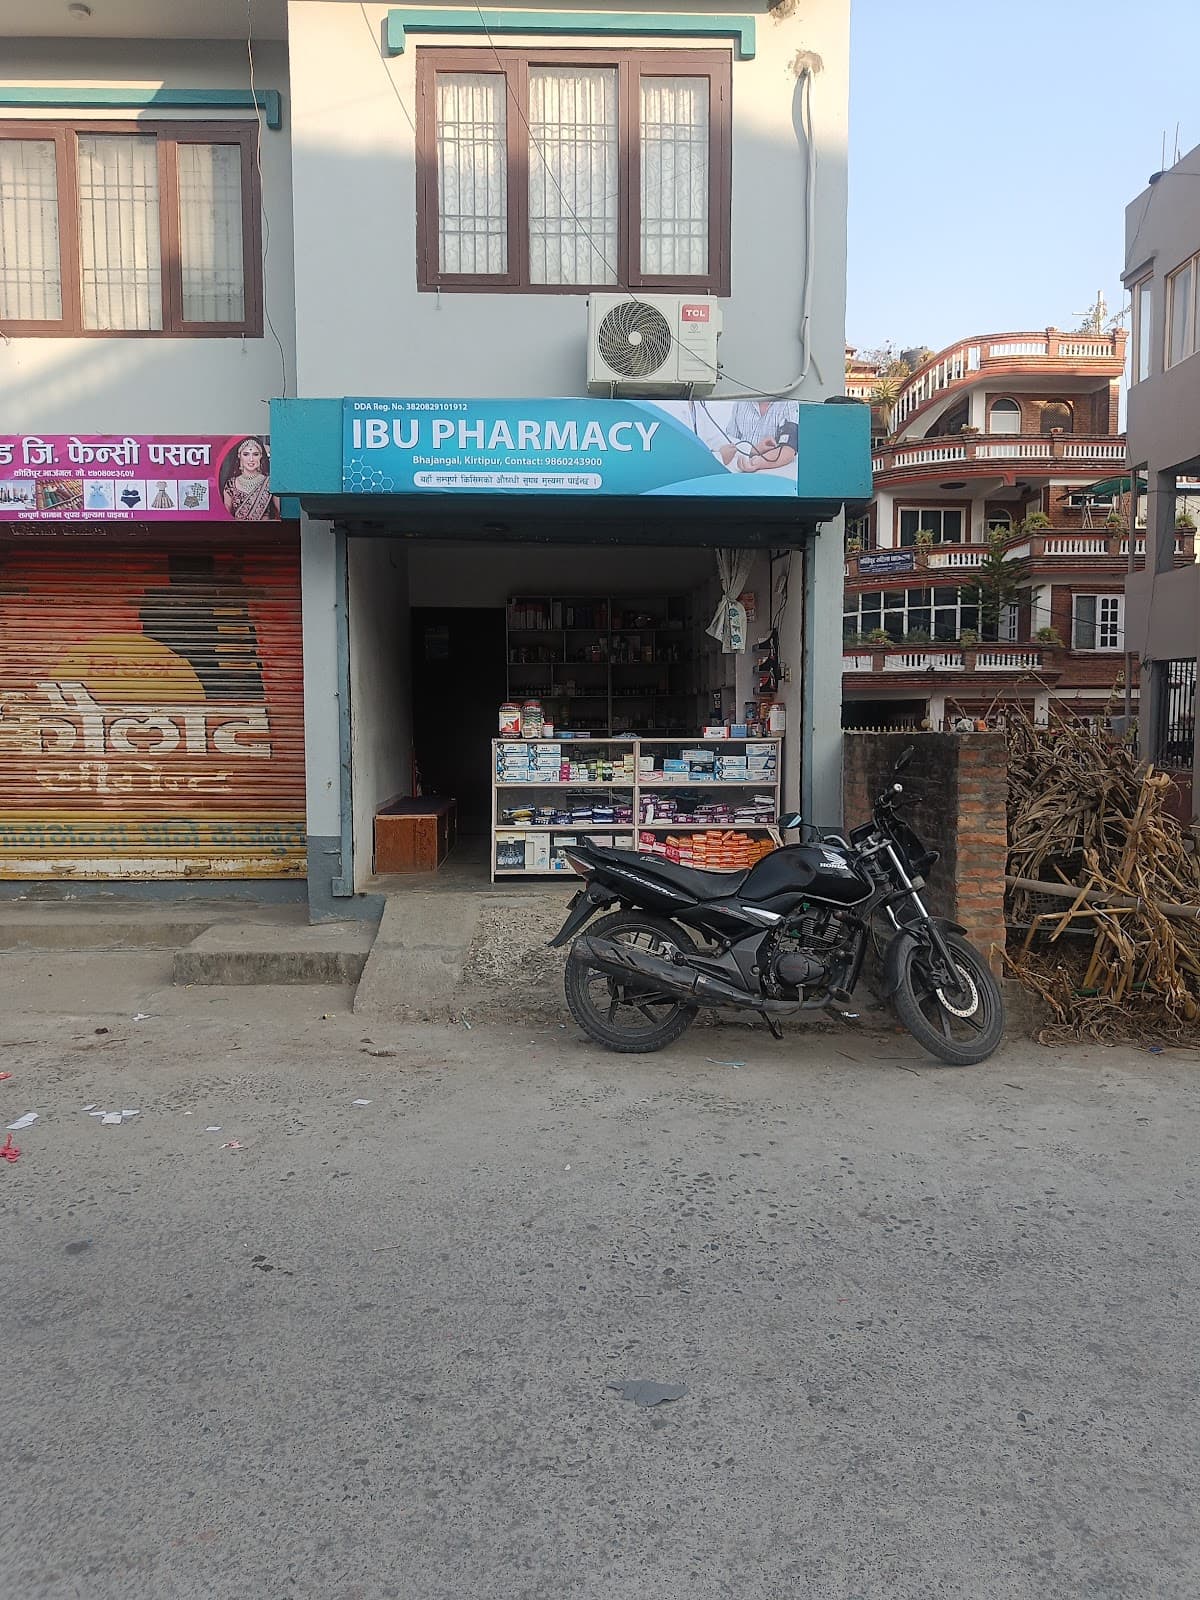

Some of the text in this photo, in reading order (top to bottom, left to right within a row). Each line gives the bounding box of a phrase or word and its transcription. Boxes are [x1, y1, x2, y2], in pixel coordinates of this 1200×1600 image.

[685, 309, 705, 317] TCL
[373, 403, 390, 411] Reg.
[352, 418, 660, 451] IBU PHARMACY
[67, 436, 140, 466] फेन्सी
[147, 443, 211, 466] पसल
[412, 455, 602, 466] Bhajangal, Kirtipur, Contact: 9860243900
[819, 862, 849, 870] HONDA
